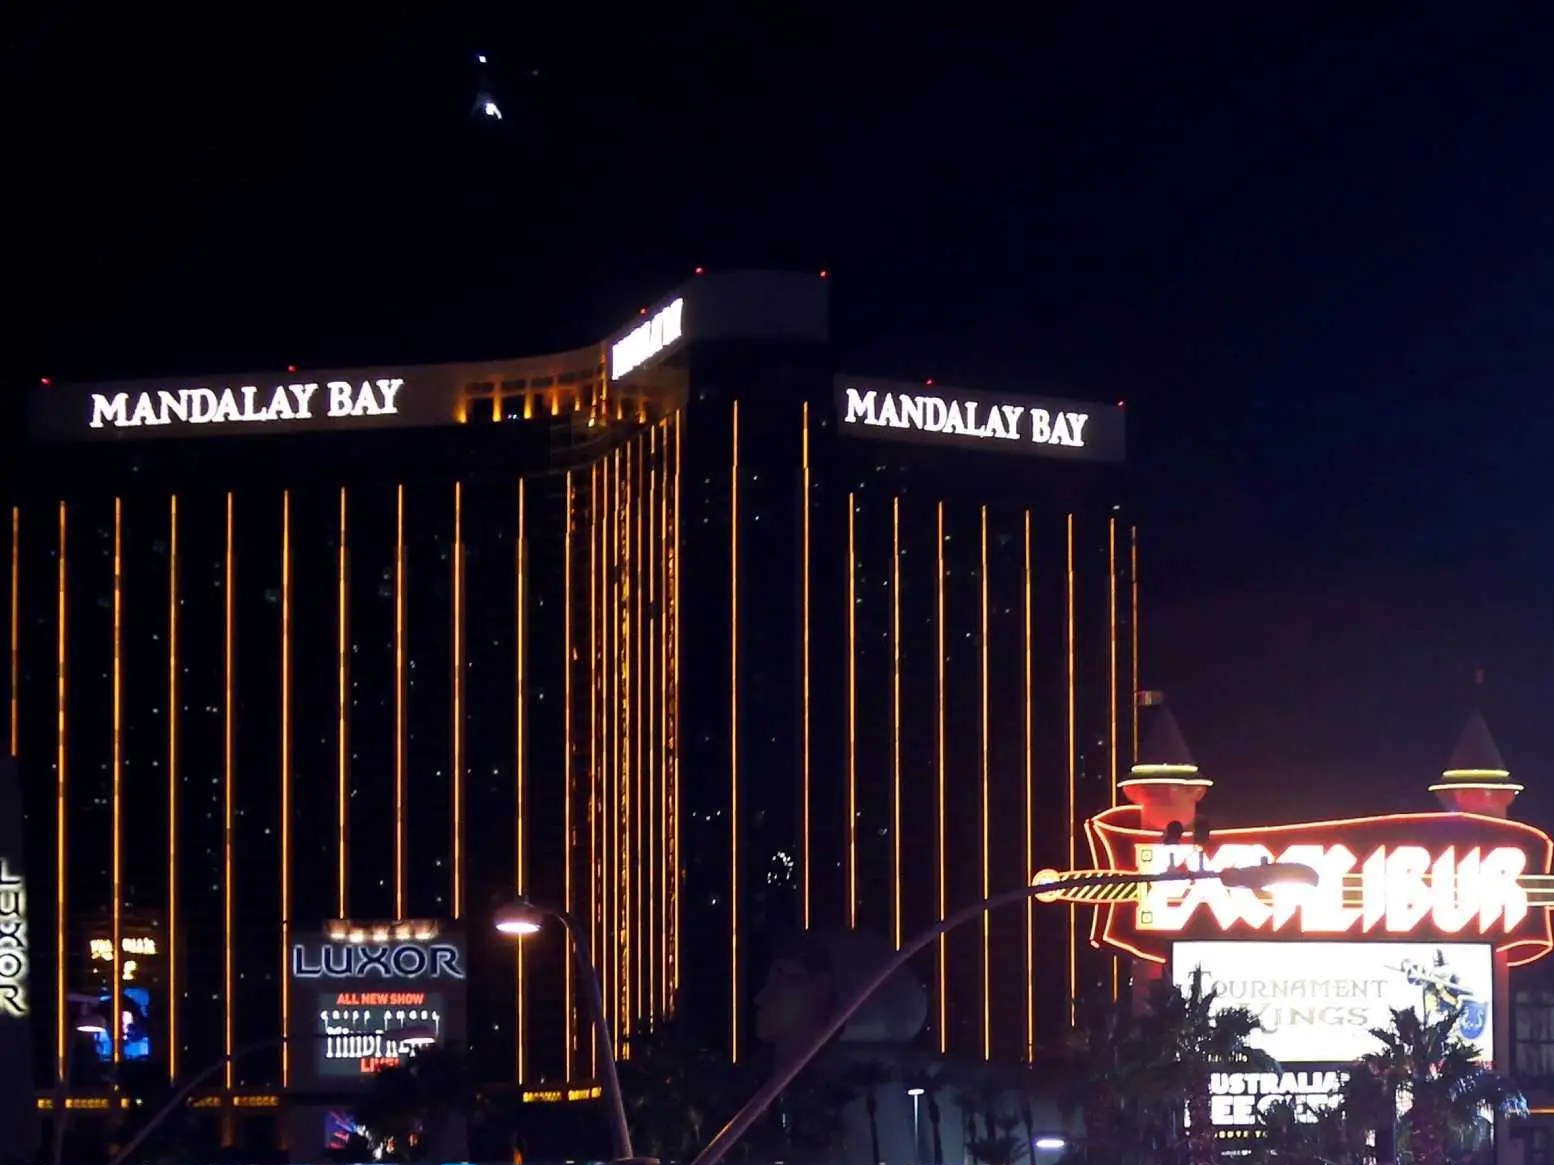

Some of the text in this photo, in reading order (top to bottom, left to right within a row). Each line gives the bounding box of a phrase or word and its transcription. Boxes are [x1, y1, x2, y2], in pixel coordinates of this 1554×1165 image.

[89, 378, 404, 428] MANDALAY BAY
[844, 388, 1089, 446] MANDALAY BAY
[293, 944, 467, 979] LUXOR
[336, 992, 425, 1005] ALL NEW SHOW
[1209, 1095, 1256, 1125] EE
